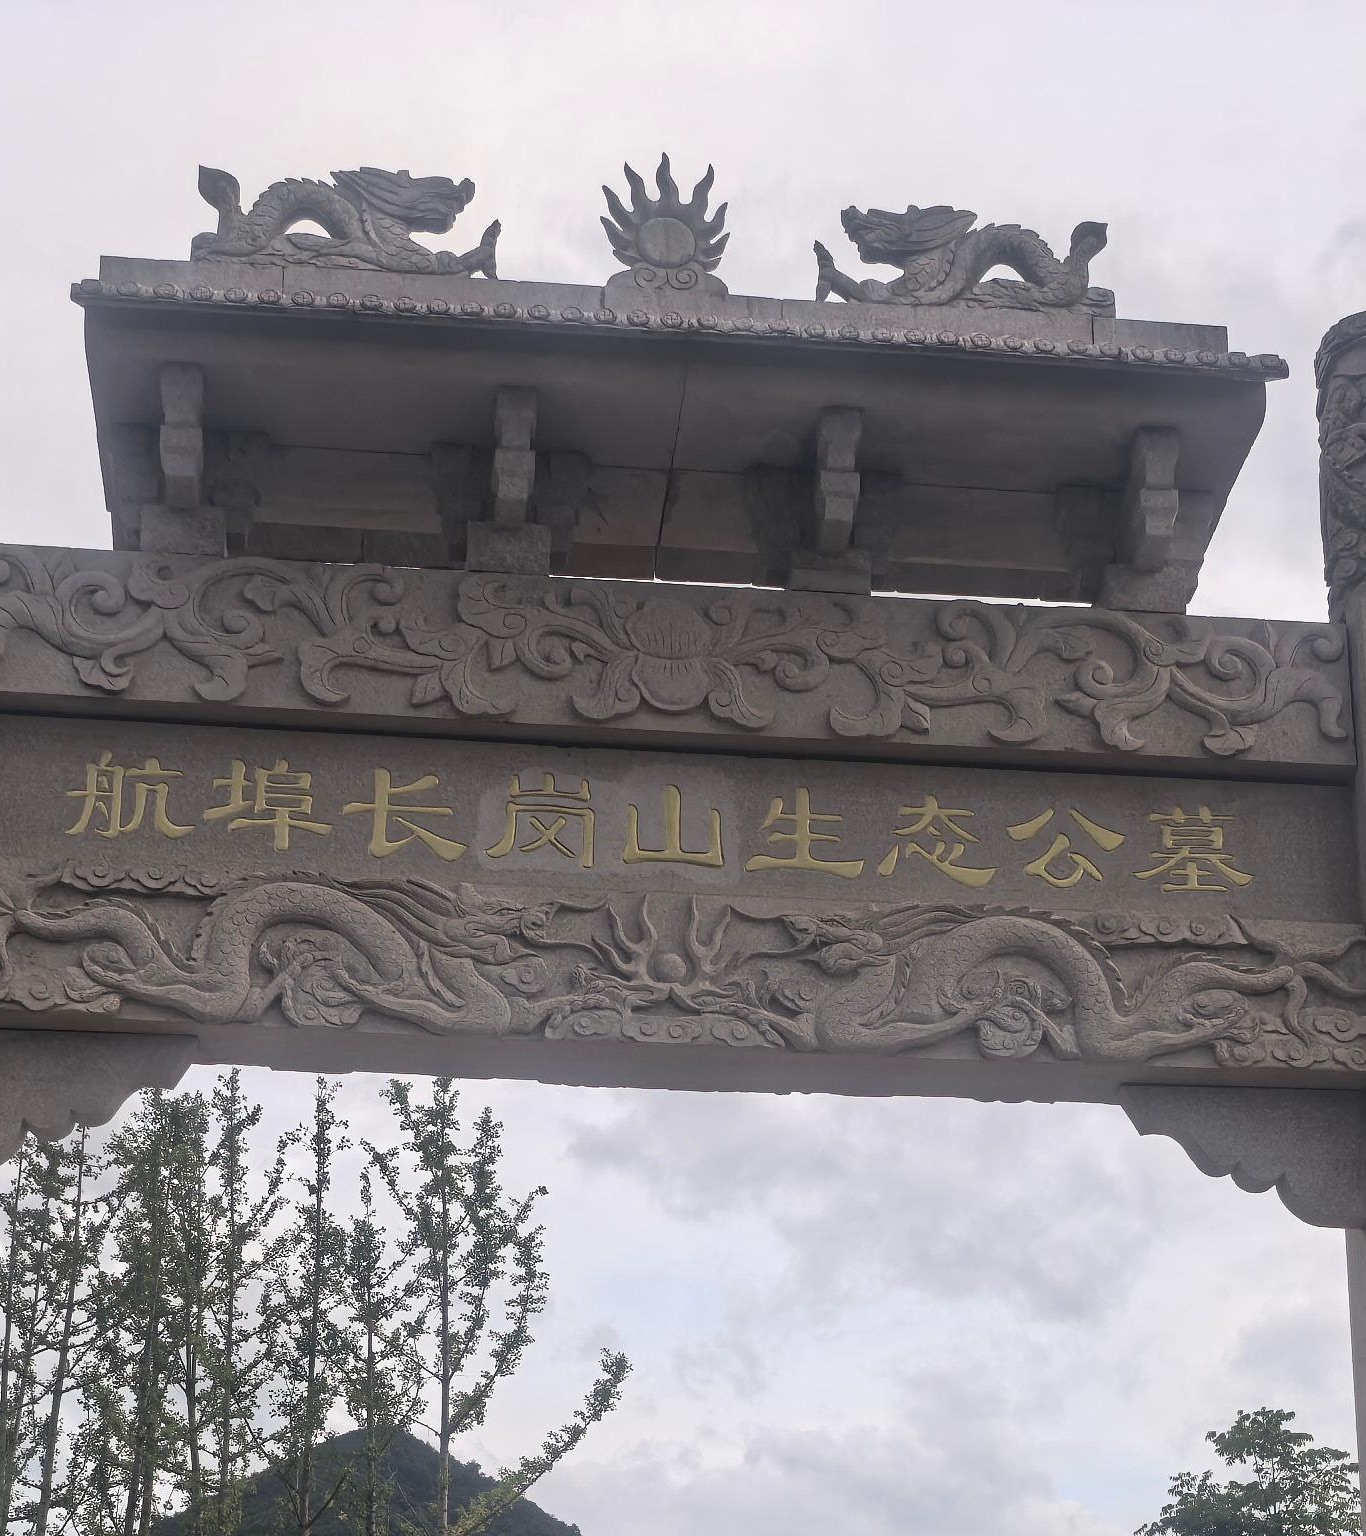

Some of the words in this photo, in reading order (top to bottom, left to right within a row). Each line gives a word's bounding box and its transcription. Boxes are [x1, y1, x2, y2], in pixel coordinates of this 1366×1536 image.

[65, 750, 1255, 893] 航埠长岗山生态公墓
